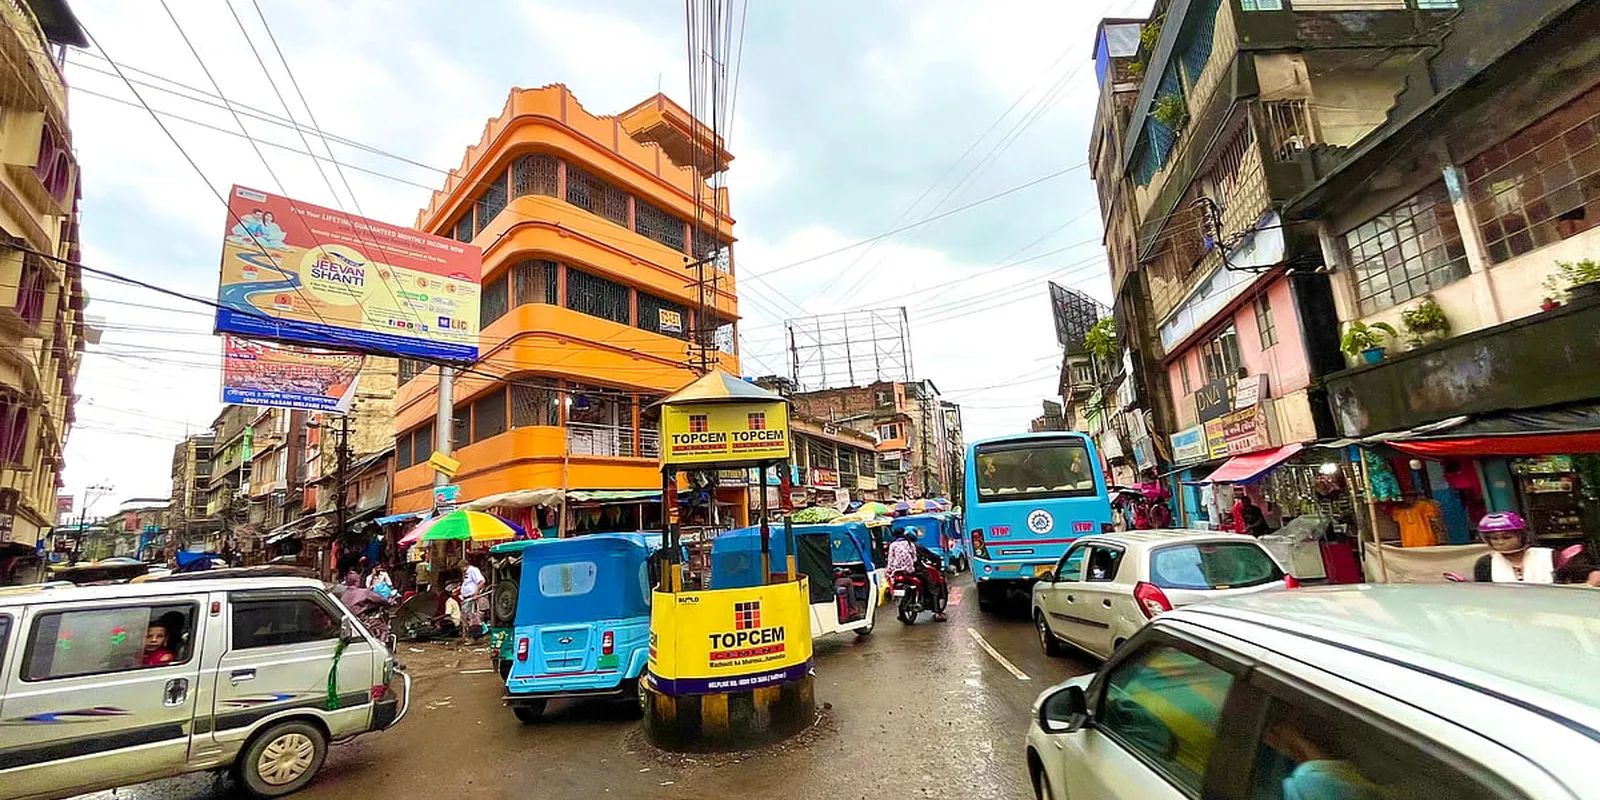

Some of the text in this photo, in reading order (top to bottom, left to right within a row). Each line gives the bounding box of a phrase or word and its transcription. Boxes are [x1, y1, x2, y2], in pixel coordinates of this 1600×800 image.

[354, 222, 396, 237] GUARANTEED
[397, 233, 425, 245] MONTHLY
[426, 239, 449, 251] INCOME
[450, 245, 464, 254] NOW
[311, 259, 365, 277] JEEVAN
[310, 268, 364, 287] SHANTI
[451, 319, 468, 330] LIC
[672, 432, 727, 444] TOPCEM
[731, 430, 784, 441] TOPCEM
[990, 526, 1010, 536] STOP
[1072, 522, 1093, 532] STOP
[709, 627, 785, 649] TOPCEM
[714, 645, 782, 659] CEMENT
